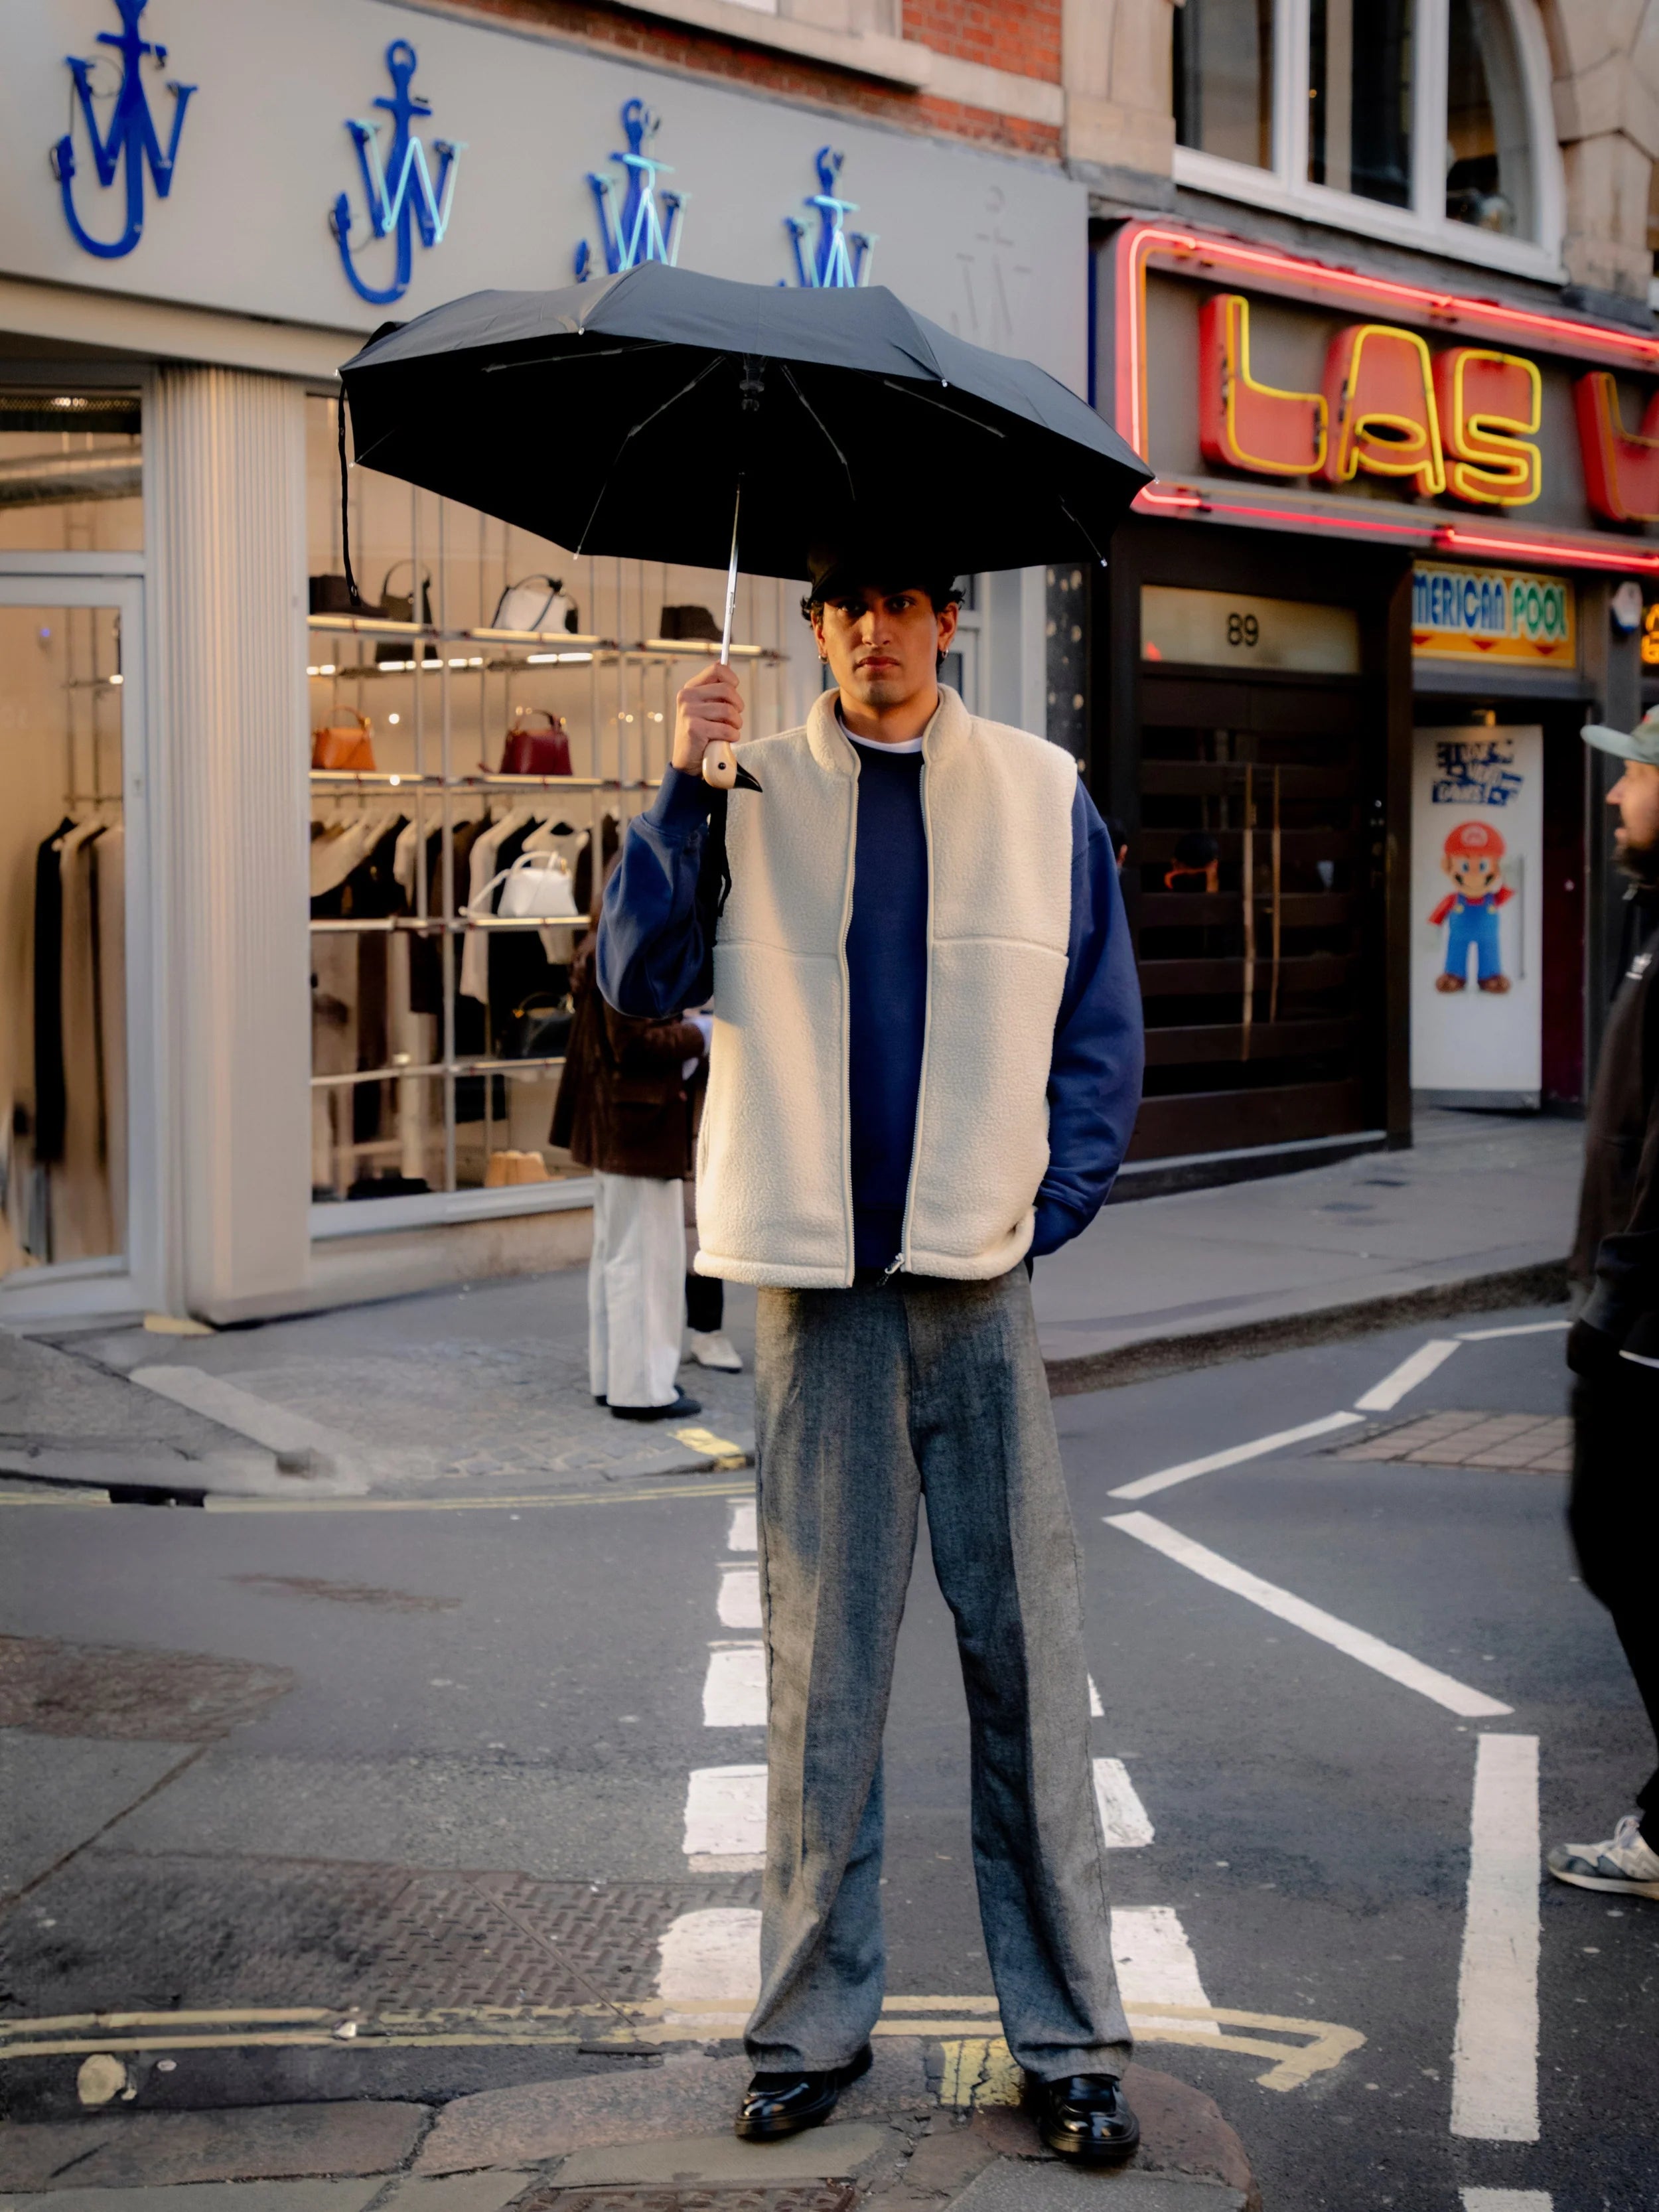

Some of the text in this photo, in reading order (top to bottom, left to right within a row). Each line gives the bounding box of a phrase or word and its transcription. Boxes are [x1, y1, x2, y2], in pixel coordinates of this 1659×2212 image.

[1198, 293, 1542, 506] LAS
[1227, 613, 1259, 647] 89
[1413, 573, 1567, 637] MERICAN POOL
